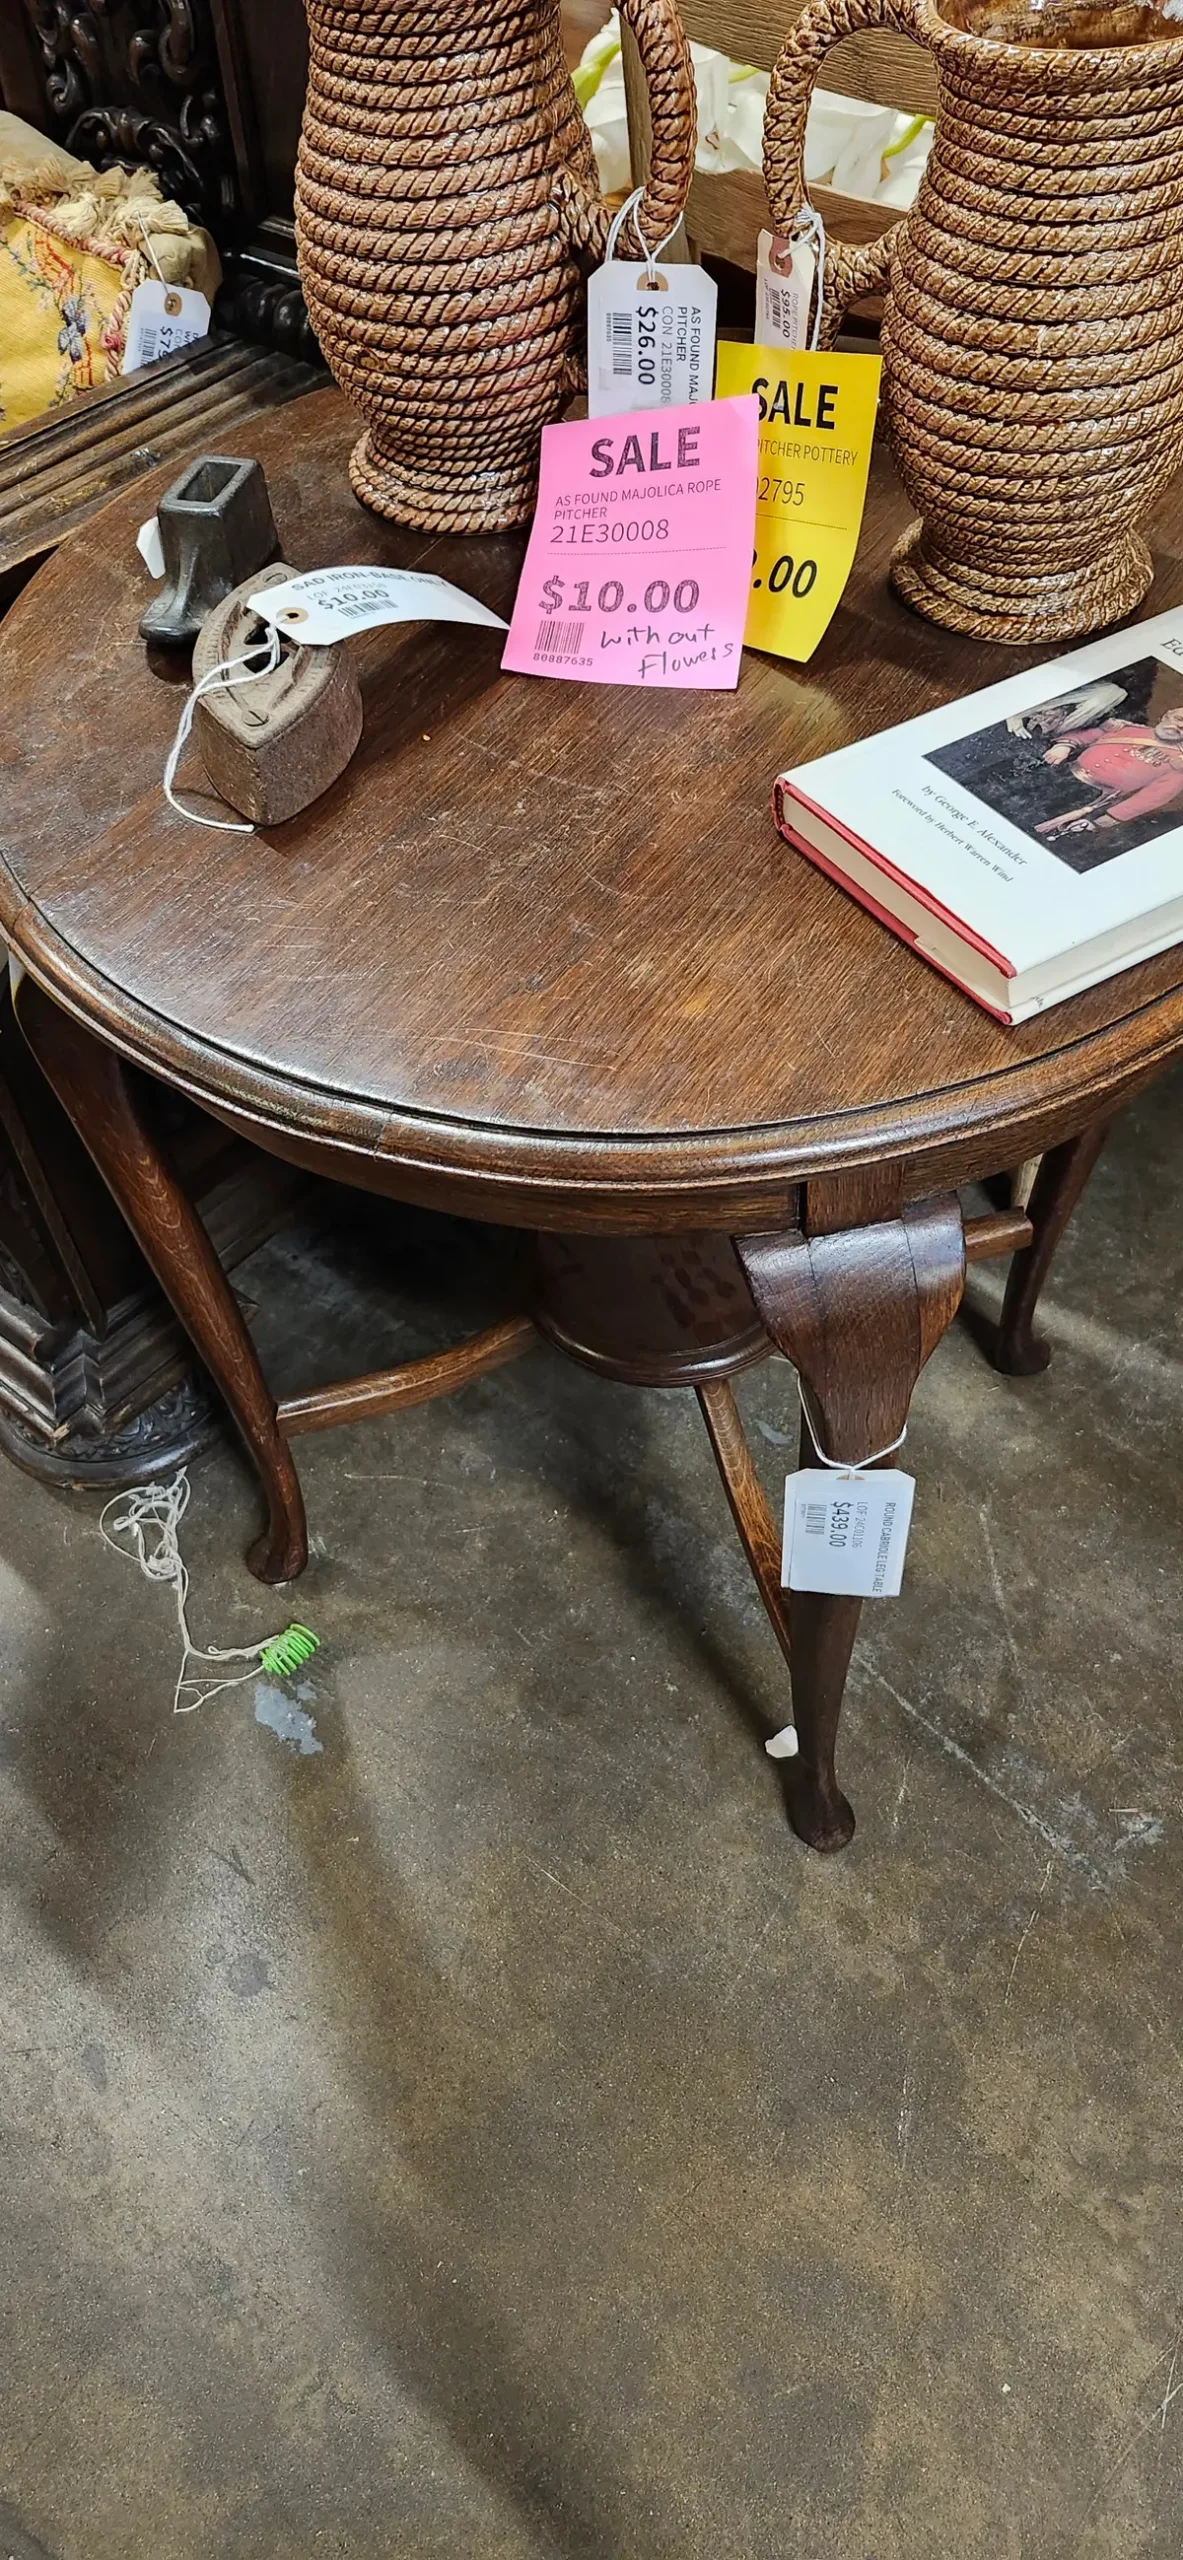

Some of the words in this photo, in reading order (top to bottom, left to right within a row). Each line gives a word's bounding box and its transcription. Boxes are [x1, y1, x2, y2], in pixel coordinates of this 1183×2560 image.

[691, 306, 701, 324] AS
[780, 289, 792, 338] $95.00
[790, 292, 799, 315] ROPE
[661, 306, 673, 335] CON
[676, 306, 687, 361] PITCHER
[636, 306, 659, 385] $26.00
[690, 328, 700, 370] FOUND
[660, 342, 672, 404] 21E30008
[752, 377, 839, 430] SALE
[589, 426, 700, 478] SALE
[802, 446, 858, 466] POTTERY
[555, 495, 571, 507] AS
[574, 490, 618, 506] FOUND
[621, 484, 684, 502] MAJOLICA
[688, 478, 722, 492] ROPE
[756, 476, 805, 507] 2795
[554, 506, 608, 520] PITCHER
[550, 518, 670, 544] 21E30008
[291, 578, 326, 591] SAD
[327, 572, 410, 583] IRON-BASE
[752, 550, 818, 598] .00
[318, 589, 390, 610] $10.00
[538, 574, 700, 615] $10.00
[532, 652, 594, 666] 80887635
[891, 788, 930, 816] Foreword
[924, 814, 937, 824] by
[934, 821, 965, 846] Herbert
[964, 844, 992, 866] Warren
[992, 864, 1015, 883] Wind
[921, 786, 936, 797] by
[934, 795, 970, 822] George
[976, 828, 1028, 866] Alexander
[856, 1502, 868, 1516] LOF
[882, 1502, 896, 1528] ROUND
[829, 1501, 854, 1548] $439.00
[877, 1527, 893, 1560] CABRIOLE
[875, 1560, 888, 1573] LEG
[872, 1573, 885, 1593] TABLE
